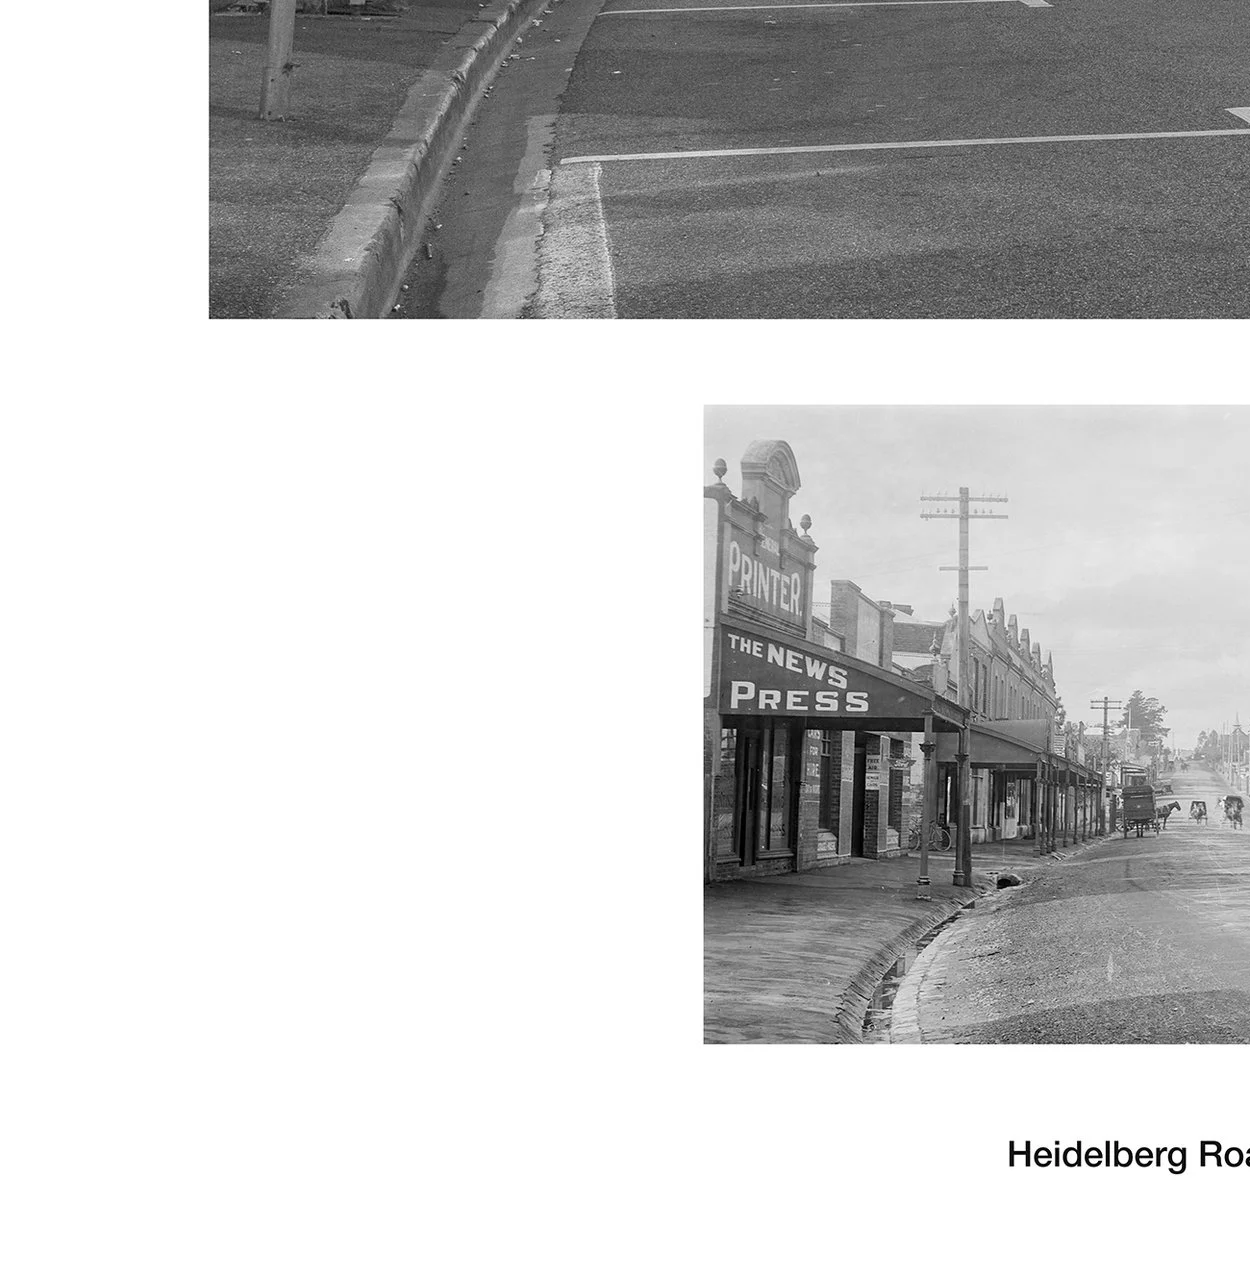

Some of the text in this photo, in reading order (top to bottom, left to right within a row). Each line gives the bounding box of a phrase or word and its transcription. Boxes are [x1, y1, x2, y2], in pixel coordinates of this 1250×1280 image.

[728, 633, 848, 690] THE NEWS
[730, 681, 869, 712] PRESS
